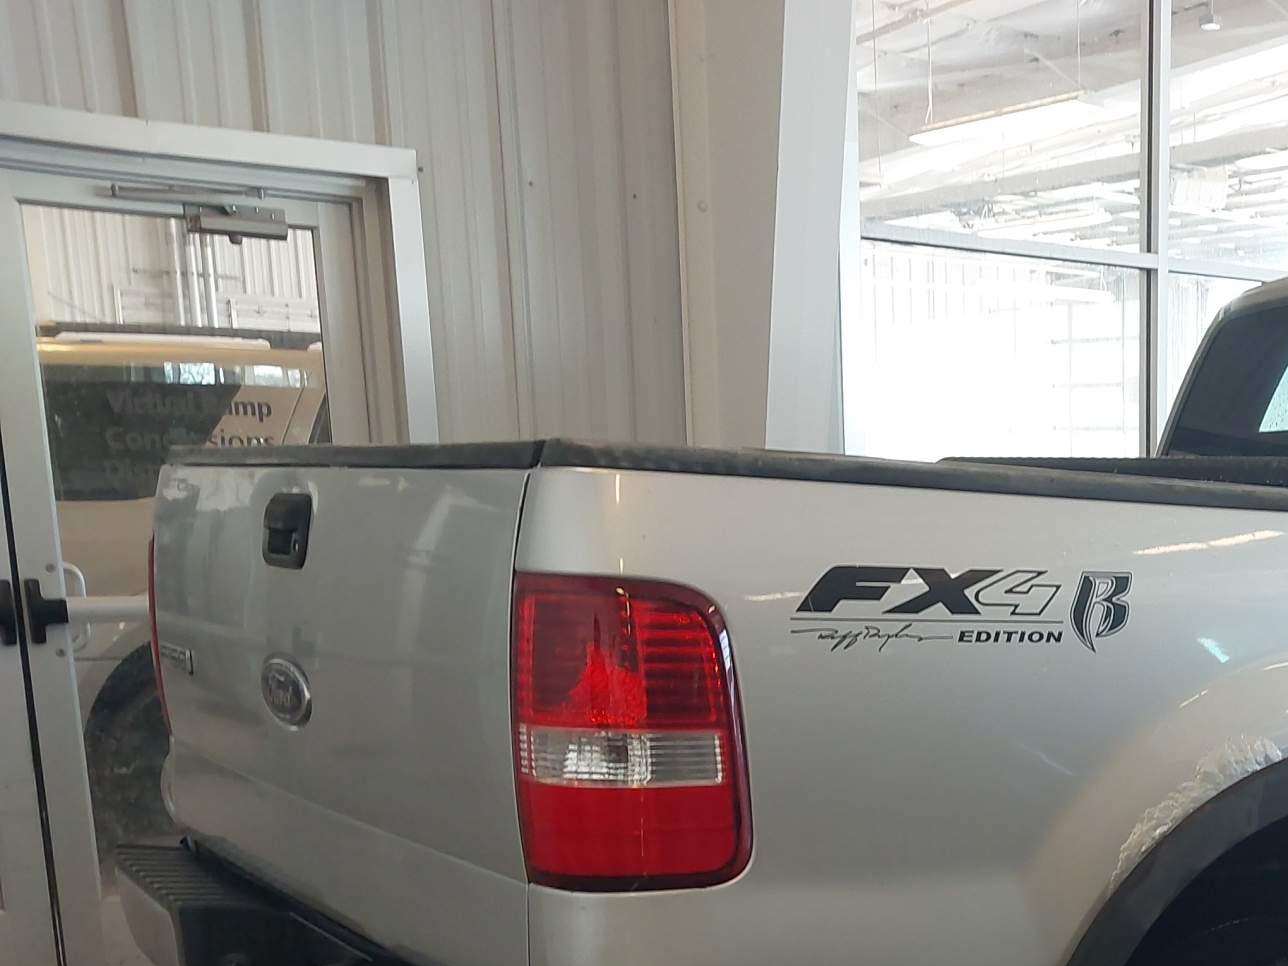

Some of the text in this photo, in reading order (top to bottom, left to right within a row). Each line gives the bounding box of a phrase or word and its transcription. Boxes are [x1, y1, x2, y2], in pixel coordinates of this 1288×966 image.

[201, 390, 272, 423] mp
[104, 425, 275, 450] Consions
[796, 564, 1061, 615] FX4
[957, 630, 1062, 643] EDITION
